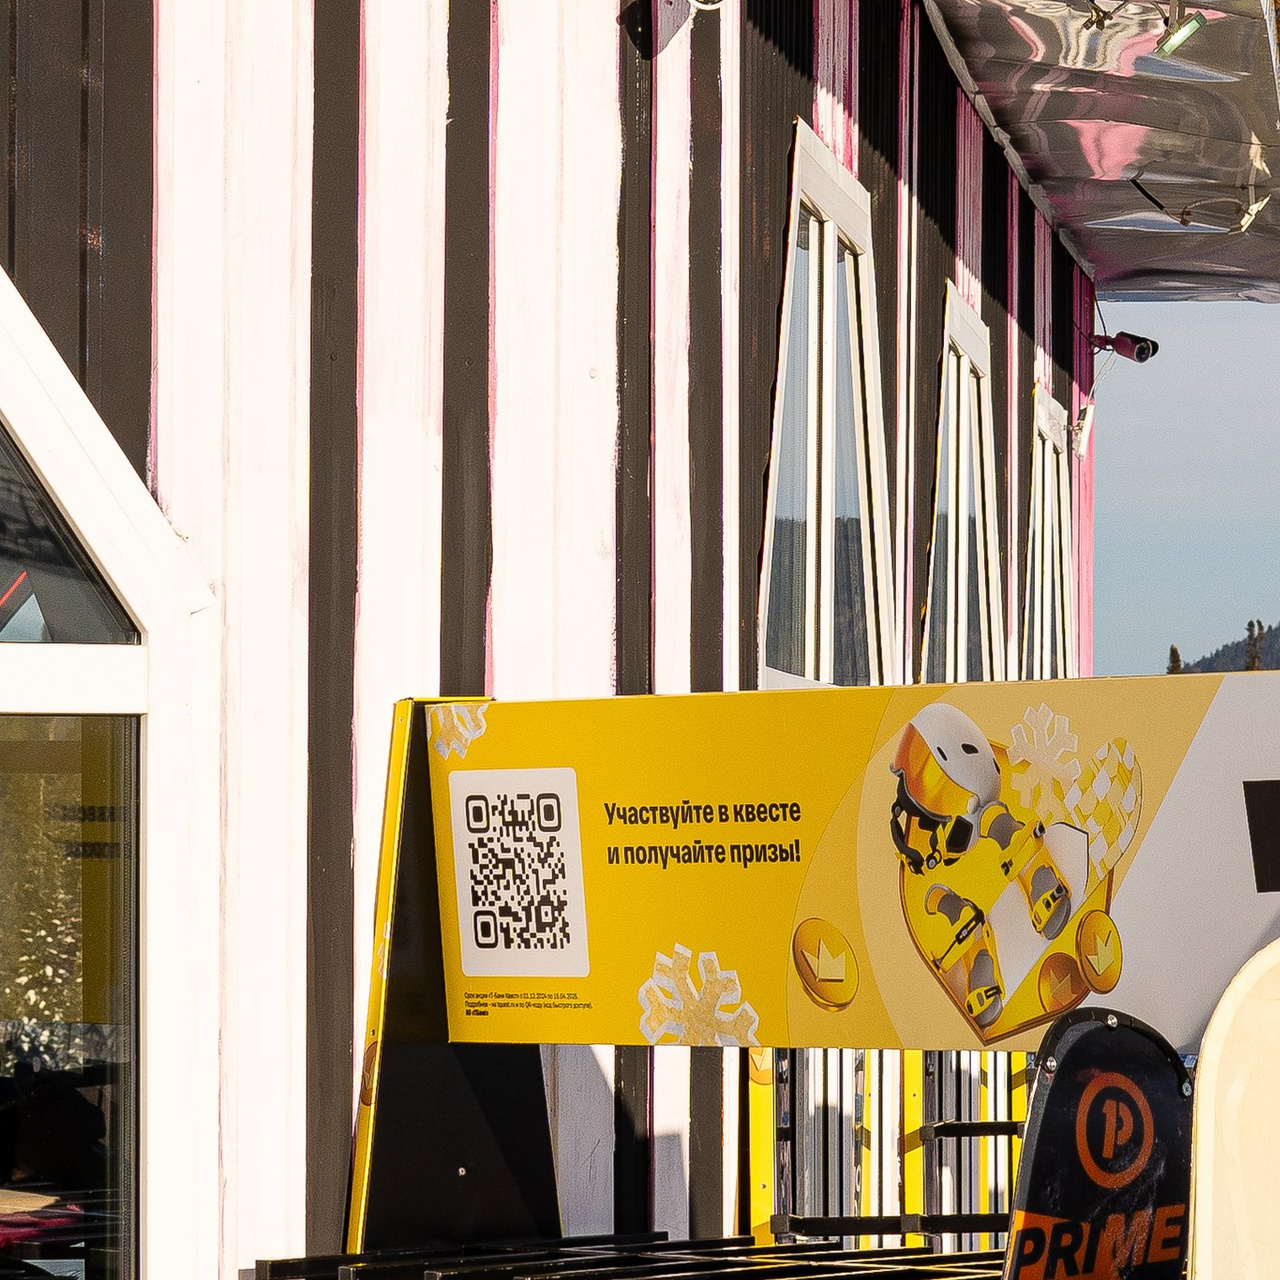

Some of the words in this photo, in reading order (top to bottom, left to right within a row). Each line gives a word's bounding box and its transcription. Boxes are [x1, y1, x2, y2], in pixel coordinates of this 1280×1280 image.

[603, 800, 714, 830] Участвуйте
[718, 804, 730, 823] в
[733, 802, 801, 823] квесте
[607, 846, 620, 865] и
[623, 840, 726, 870] получайте
[730, 839, 801, 869] призы!
